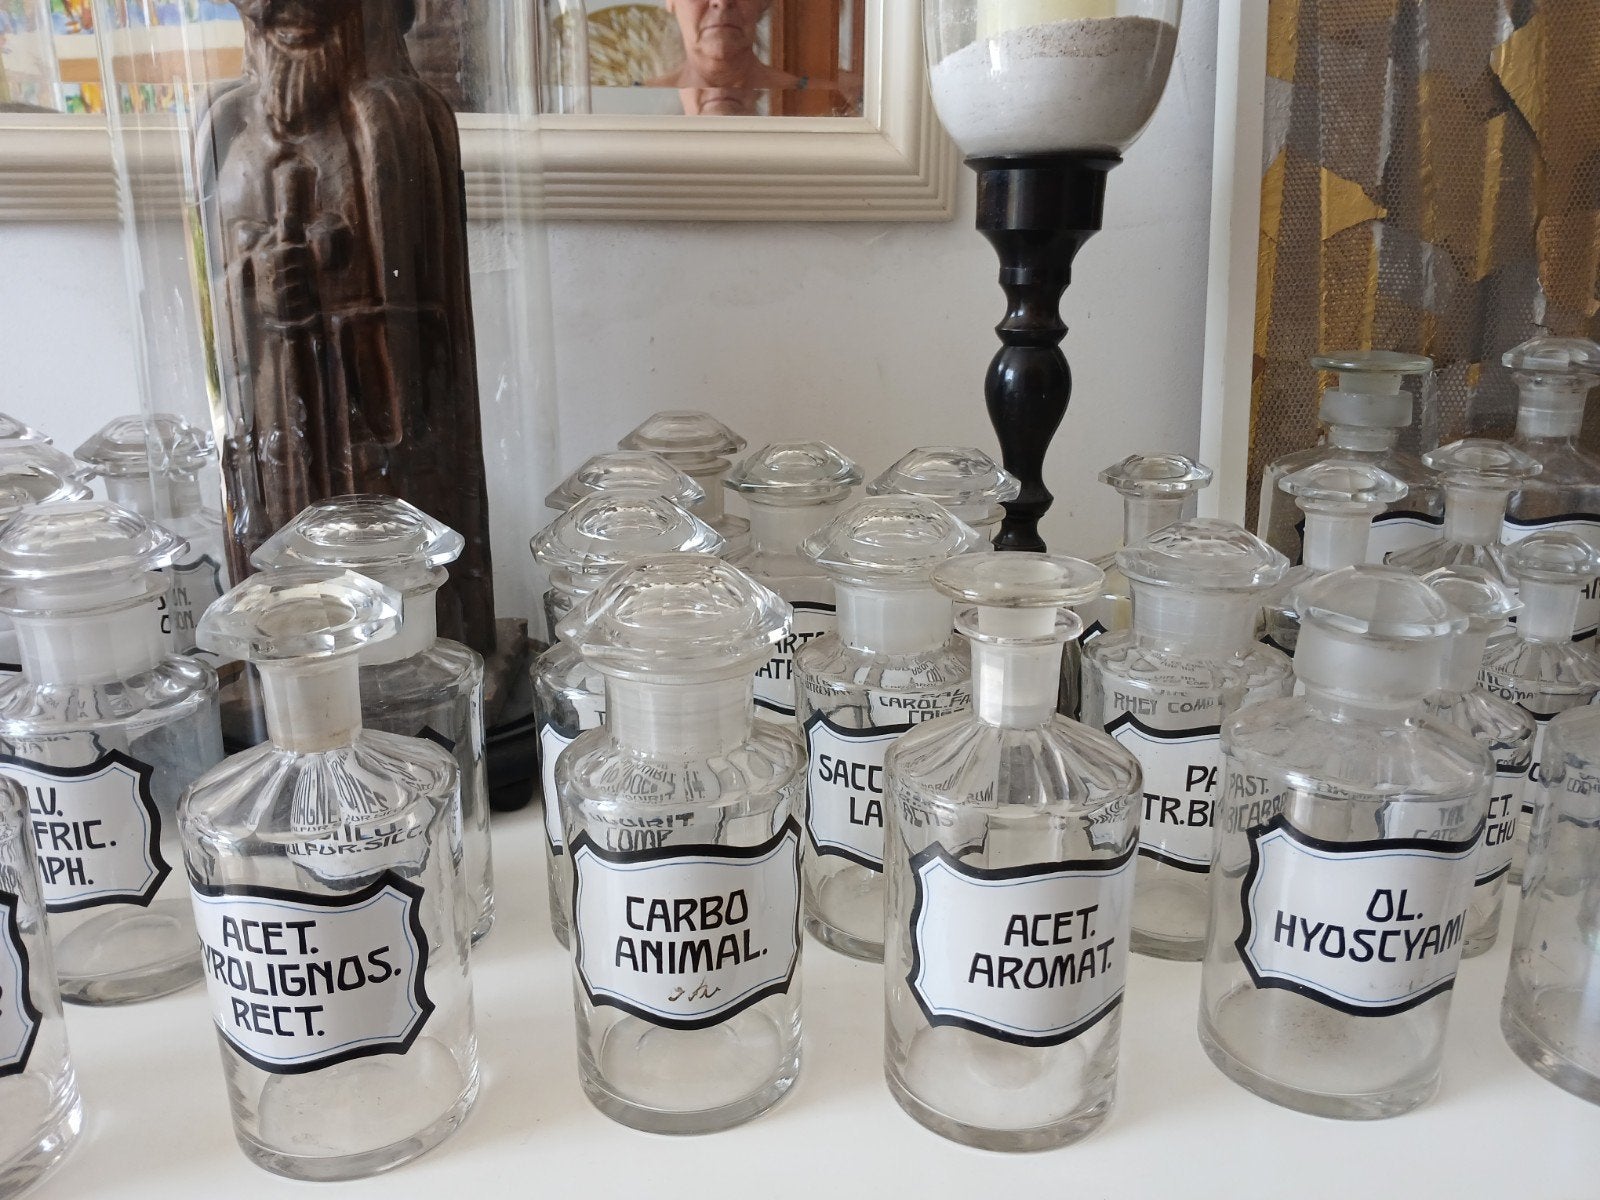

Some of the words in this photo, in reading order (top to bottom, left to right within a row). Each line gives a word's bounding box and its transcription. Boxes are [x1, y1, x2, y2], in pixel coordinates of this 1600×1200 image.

[818, 753, 884, 794] SACC
[849, 796, 884, 828] LA
[32, 819, 117, 851] FRIC.
[626, 888, 749, 933] CARBO
[1003, 904, 1100, 948] ACET.
[1365, 888, 1424, 923] OL.
[222, 914, 320, 956] ACET.
[614, 928, 768, 975] ANIMAL.
[967, 936, 1116, 990] AROMAT.
[231, 996, 325, 1037] RECT.
